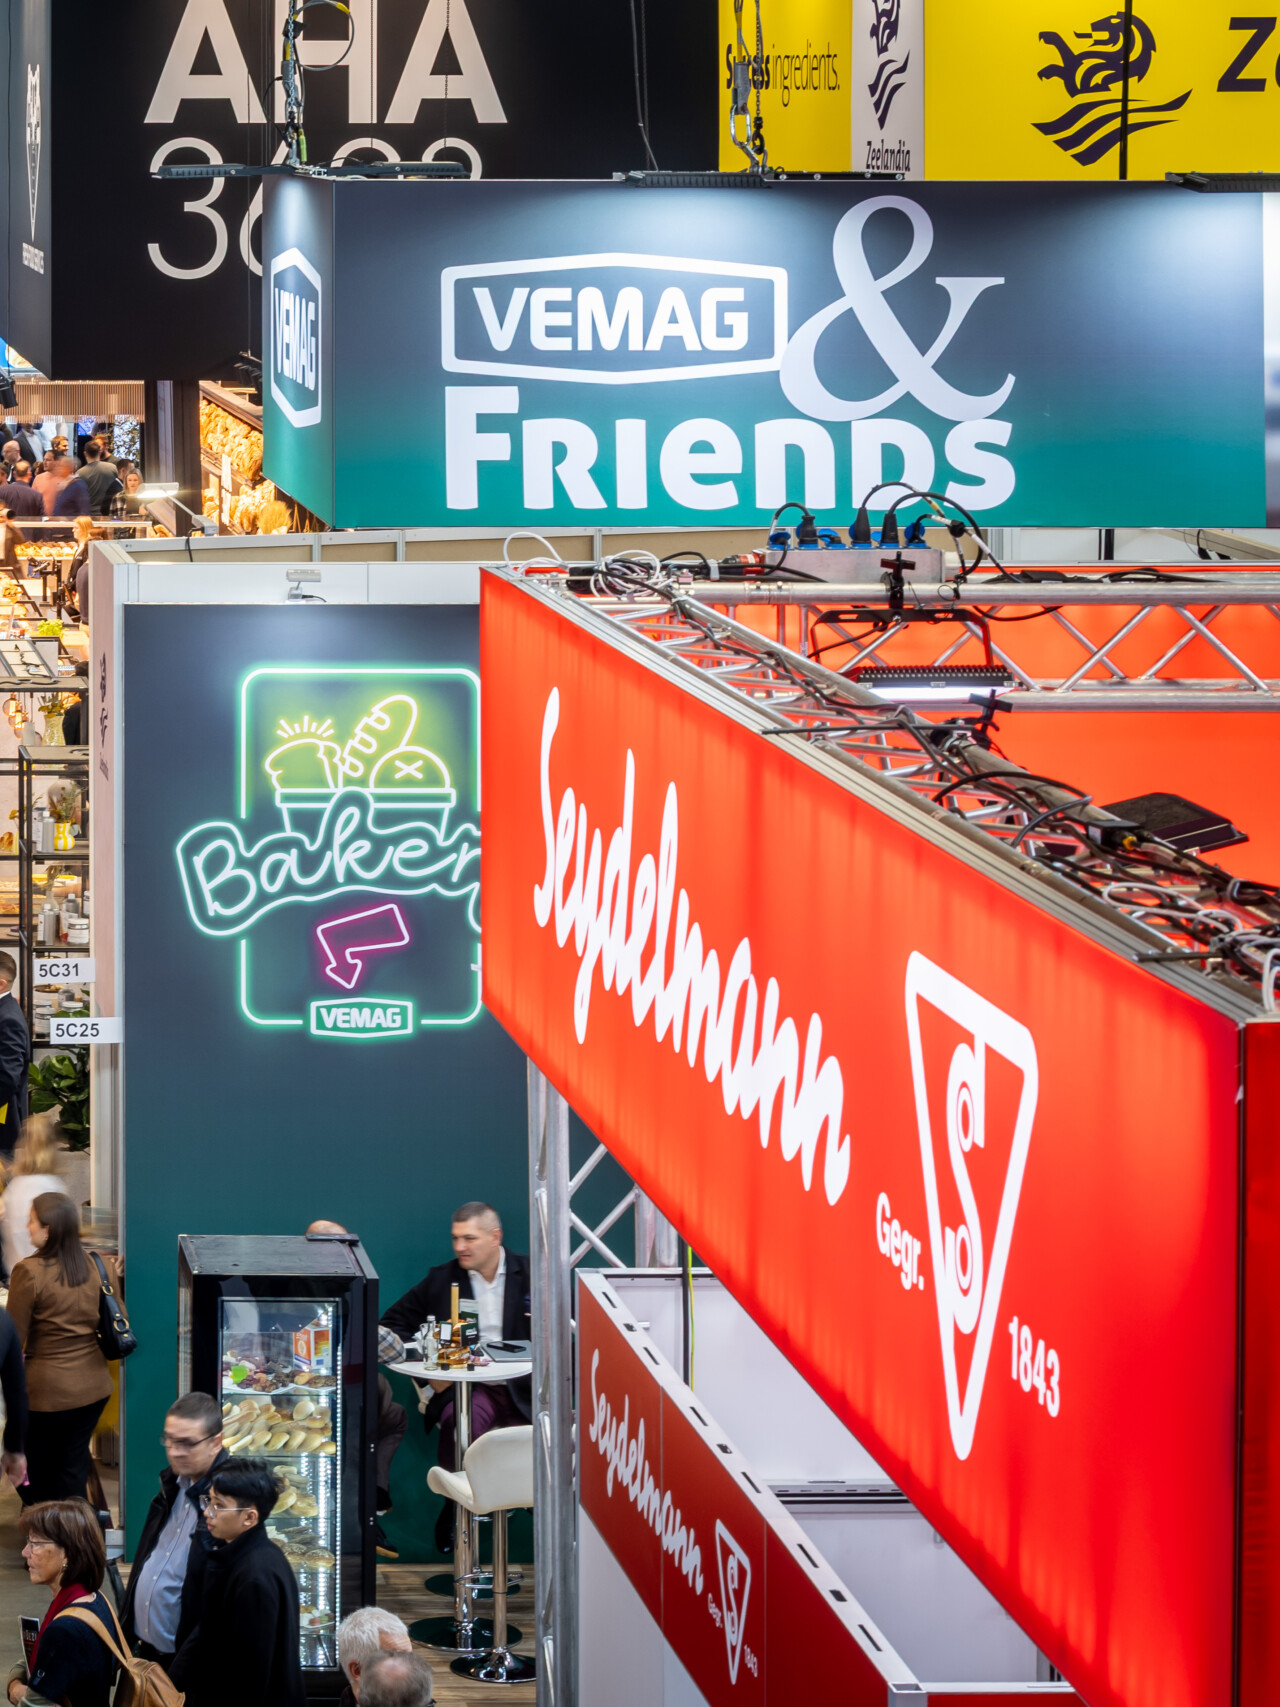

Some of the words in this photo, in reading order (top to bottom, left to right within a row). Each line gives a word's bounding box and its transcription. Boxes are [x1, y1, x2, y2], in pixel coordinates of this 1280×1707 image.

[726, 44, 770, 90] Sess
[772, 39, 840, 108] ingredients.
[1216, 16, 1280, 92] Z
[866, 139, 911, 172] Zeelandia
[275, 287, 316, 391] VEMAG
[472, 287, 748, 352] VEMAG
[780, 195, 1015, 421] &
[192, 806, 481, 917] Baker
[38, 963, 80, 979] 5C31
[533, 685, 851, 1206] Seydelmann
[55, 1022, 100, 1039] 5C25
[319, 1006, 402, 1029] VEMAG
[876, 1191, 925, 1291] Gegr.
[1008, 1315, 1061, 1418] 1843
[589, 1347, 704, 1596] Seydelmann
[744, 1644, 758, 1677] 1843
